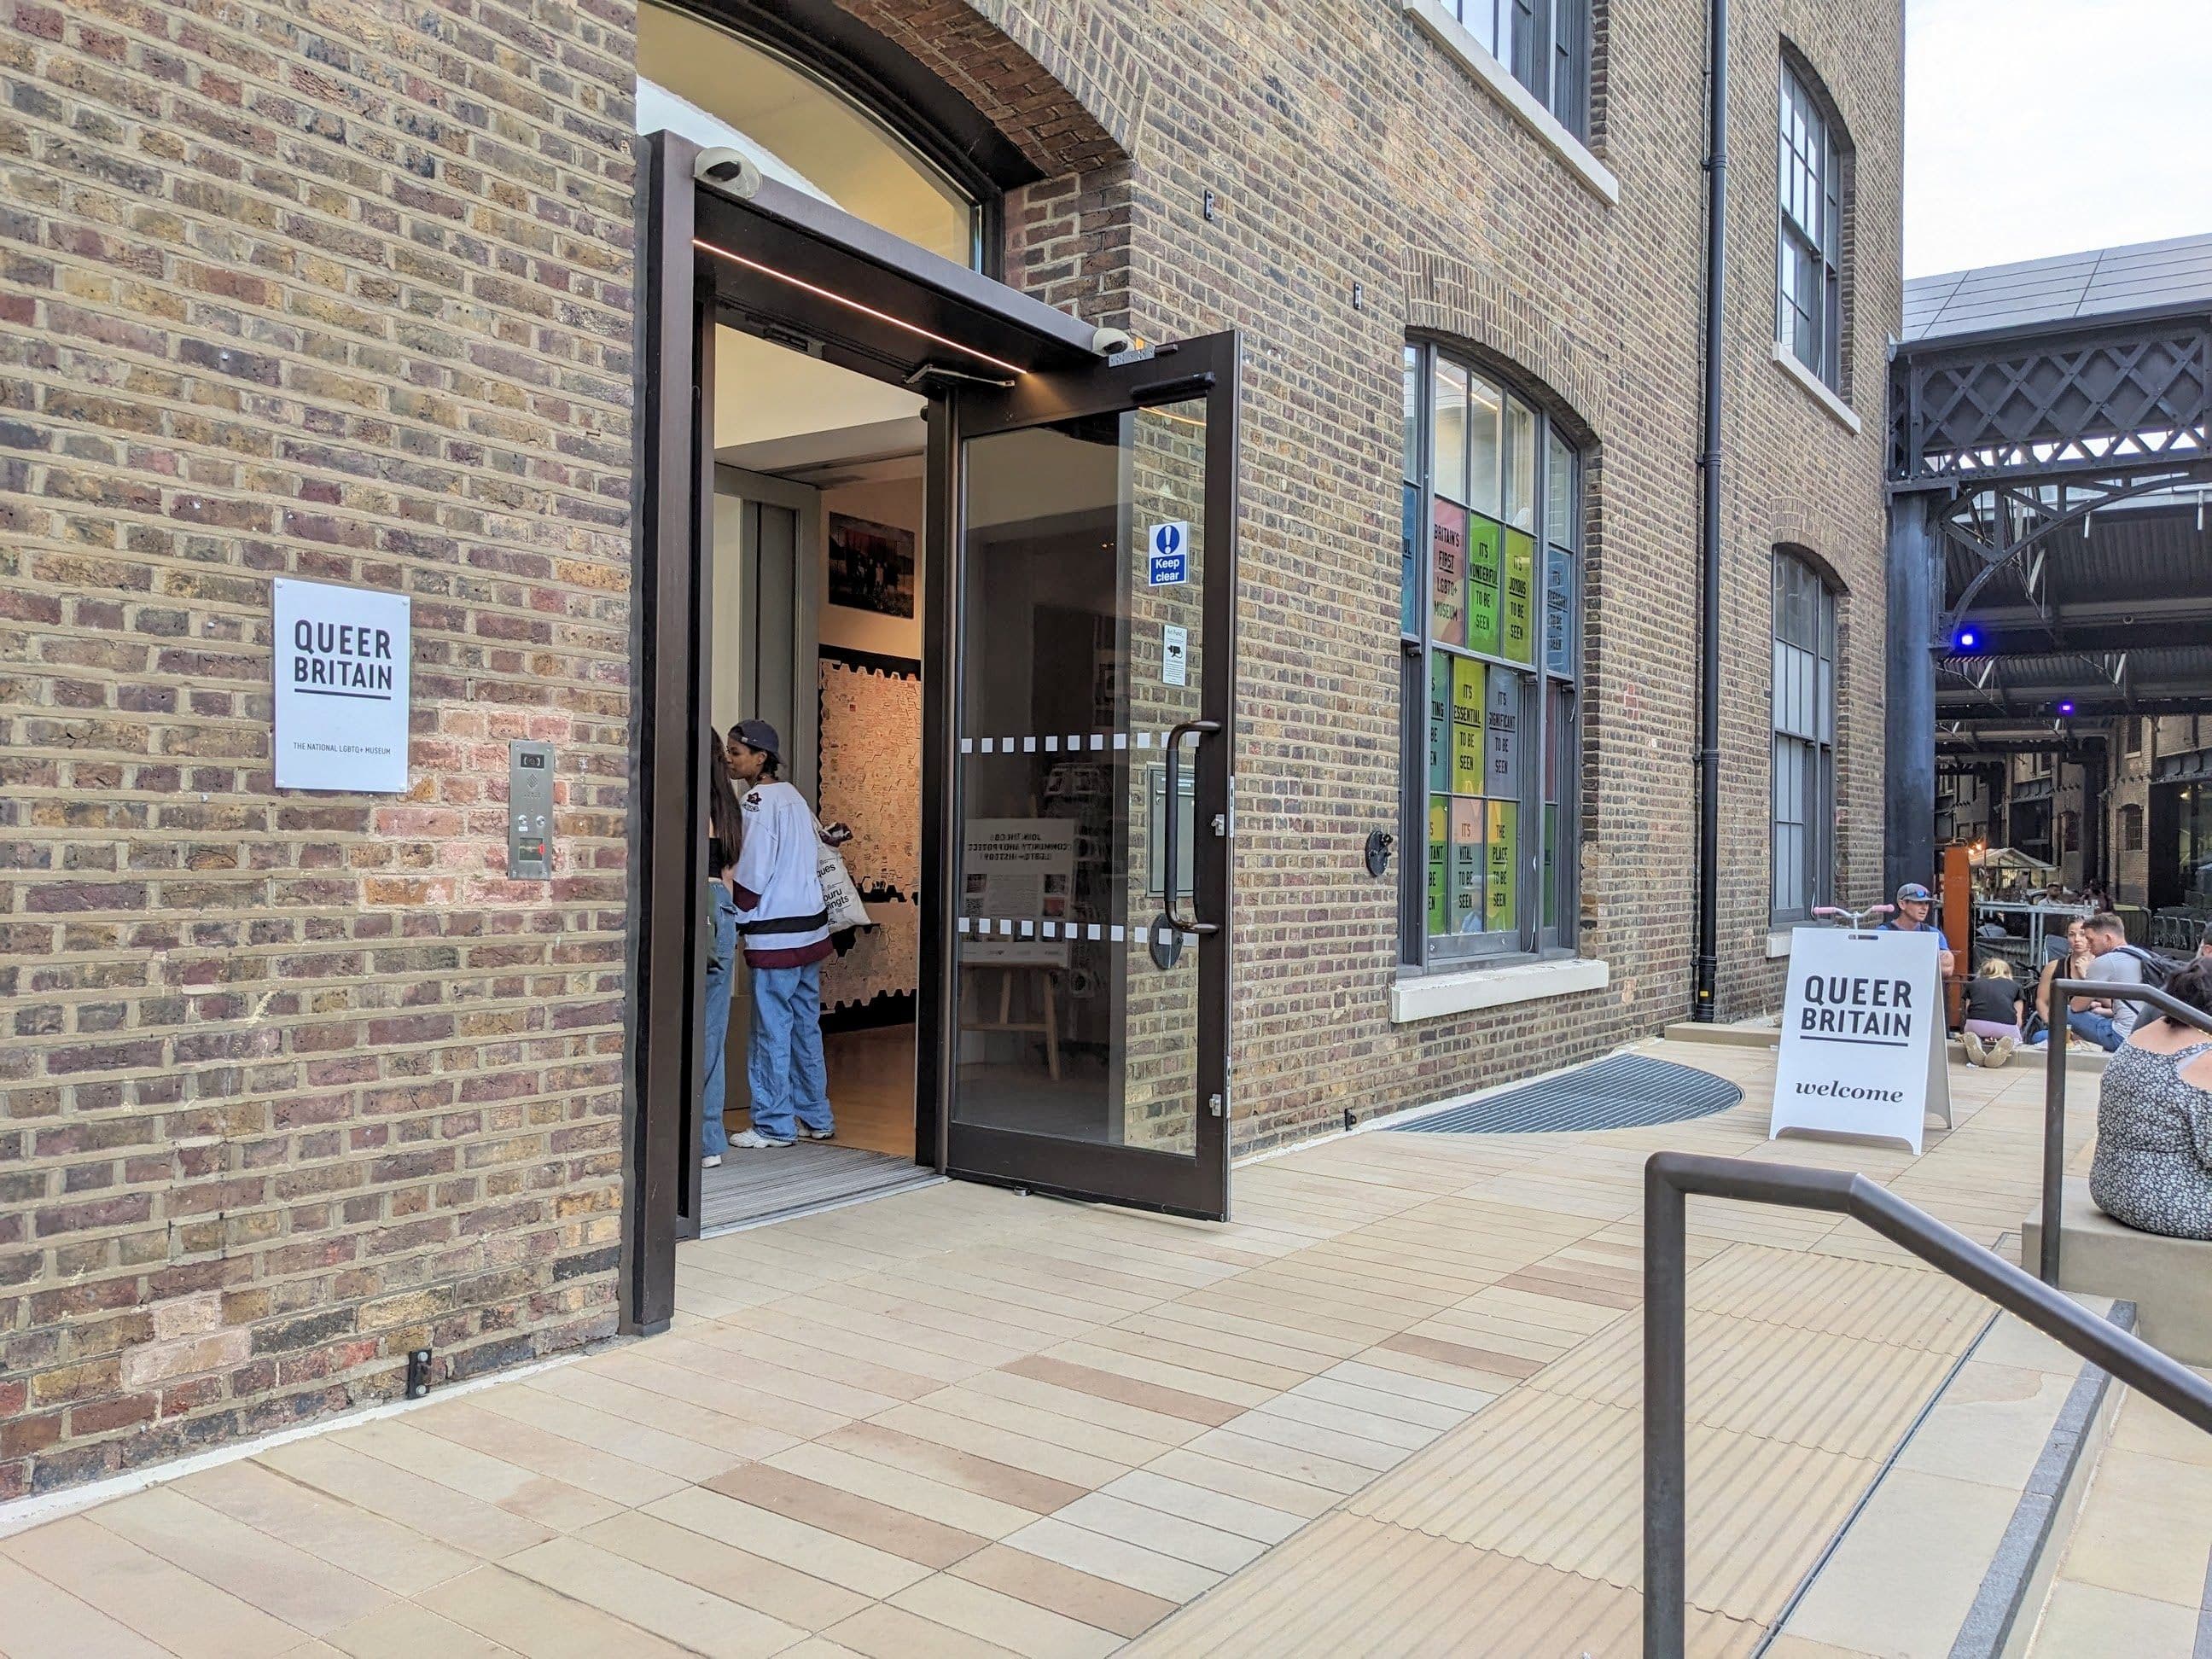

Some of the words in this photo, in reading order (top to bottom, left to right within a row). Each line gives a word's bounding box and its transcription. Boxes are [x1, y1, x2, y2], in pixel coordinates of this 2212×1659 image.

[1435, 524, 1459, 547] BRITAIN'S
[1479, 543, 1488, 558] IT'S
[1155, 558, 1179, 570] Keep
[1439, 550, 1454, 569] FIRST
[1514, 556, 1522, 572] IT'S
[1155, 570, 1179, 582] clear
[1437, 577, 1458, 596] LGBTQ+
[1509, 577, 1527, 595] JOYOUS
[1476, 591, 1482, 604] TO
[1483, 592, 1490, 608] BE
[1434, 604, 1458, 621] MUSEUM
[1511, 601, 1516, 616] TO
[1517, 602, 1524, 620] BE
[1476, 614, 1490, 631] SEEN
[294, 619, 392, 660] QUEER
[1511, 625, 1522, 640] SEEN
[294, 656, 392, 690] BRITAIN
[1463, 684, 1473, 700] IT'S
[1498, 691, 1507, 706] IT'S
[1454, 705, 1481, 724] ESSENTIAL
[1488, 712, 1516, 730] SIGNIFICANT
[1460, 731, 1466, 746] TO
[1468, 733, 1475, 748] BE
[1495, 737, 1502, 751] TO
[1502, 738, 1509, 753] BE
[294, 742, 306, 750] THE
[307, 743, 337, 753] NATIONAL
[339, 745, 364, 754] LGBTQ+
[1459, 755, 1473, 770] SEEN
[1495, 760, 1507, 774] SEEN
[1461, 823, 1471, 838] IT'S
[1497, 824, 1505, 838] THE
[1459, 846, 1473, 860] VITAL
[1493, 847, 1508, 860] PLACE
[1429, 871, 1435, 886] BE
[1459, 871, 1465, 886] TO
[1466, 871, 1473, 886] BE
[1493, 871, 1499, 885] TO
[1500, 870, 1507, 885] BE
[1459, 894, 1473, 908] SEEN
[1493, 893, 1506, 907] SEEN
[1804, 975, 1912, 1009] QUEER
[1801, 1007, 1912, 1038] BRITAIN
[1796, 1080, 1903, 1103] welcome
